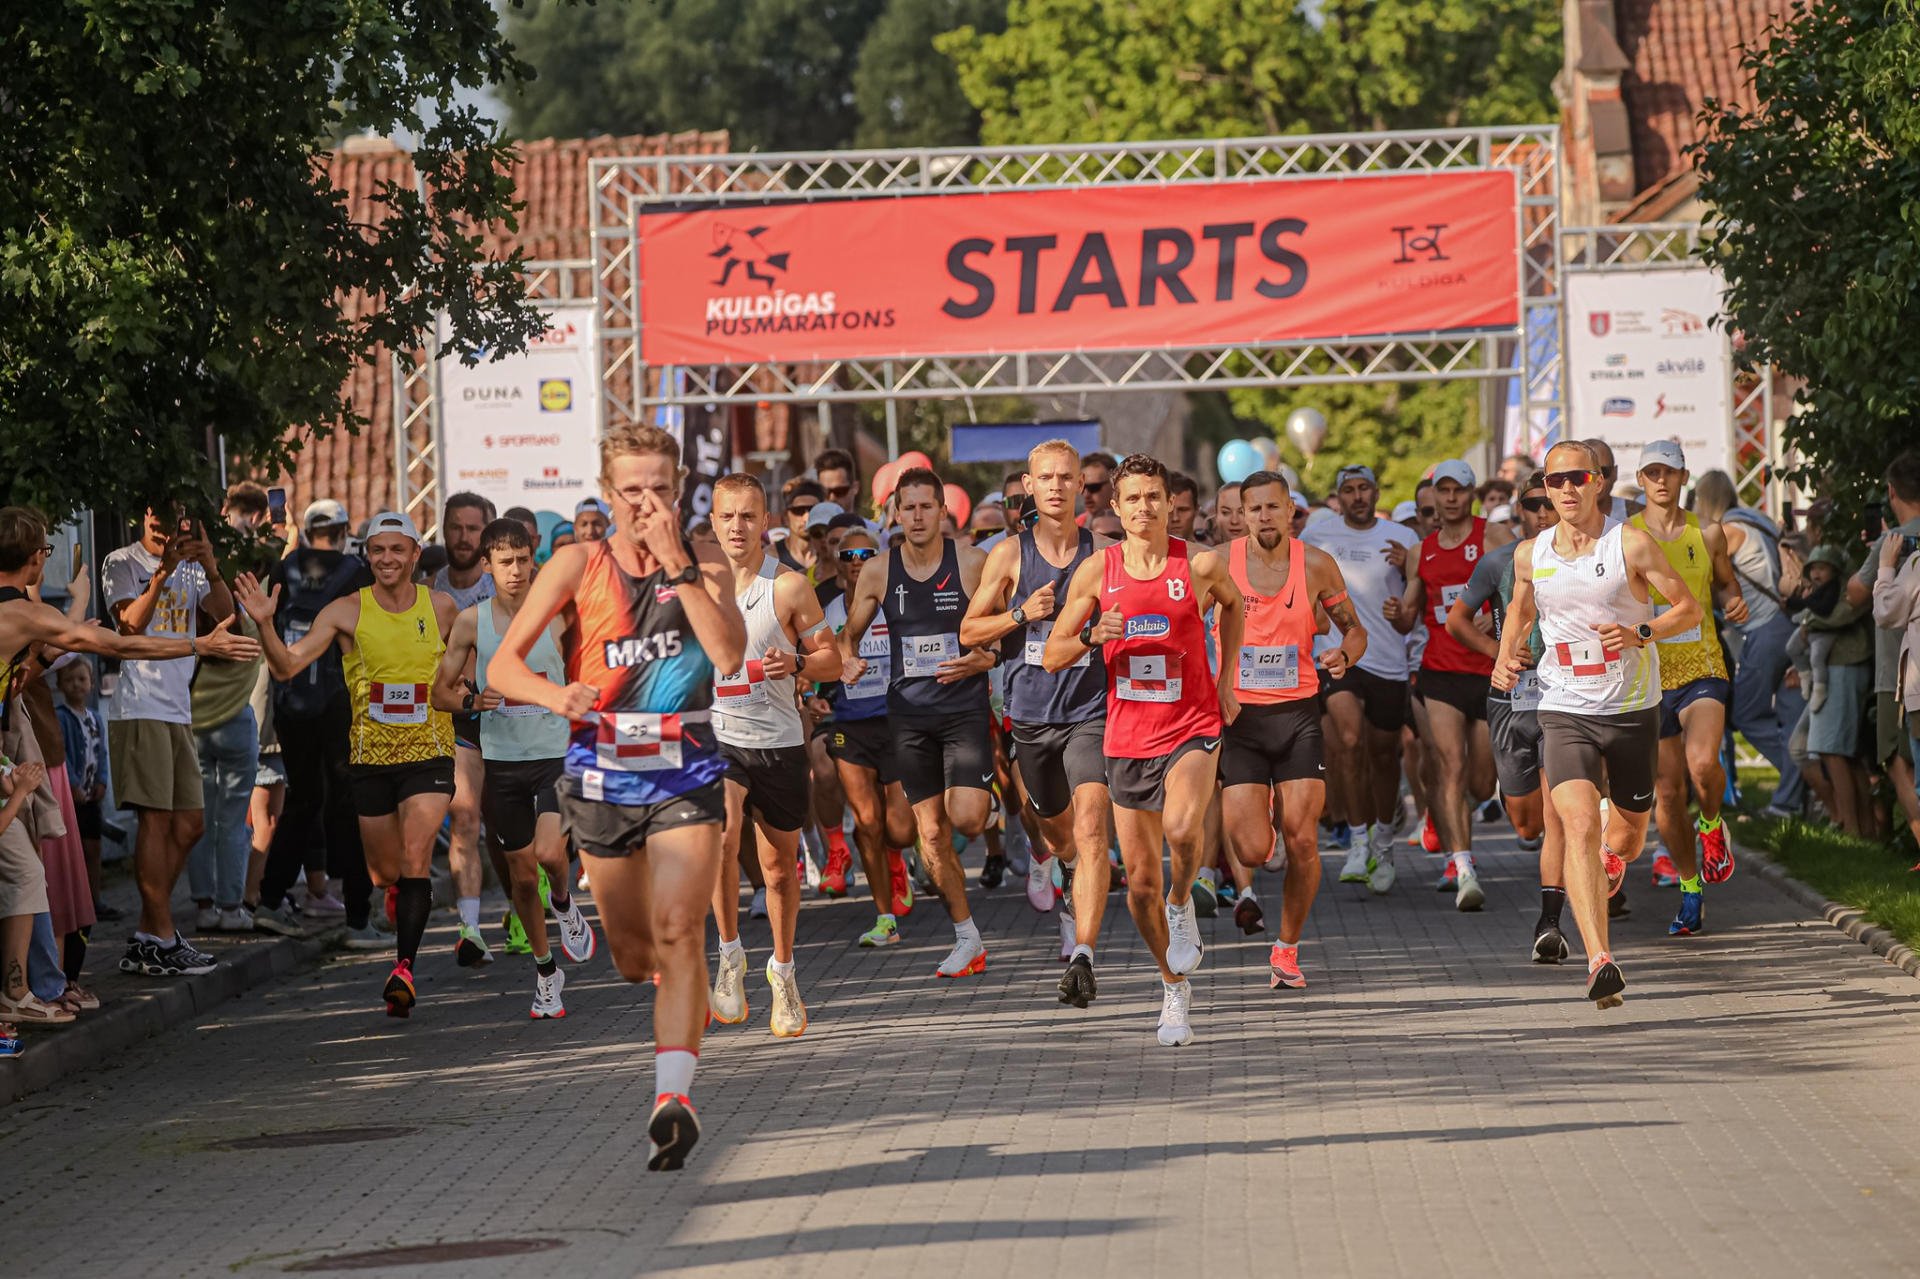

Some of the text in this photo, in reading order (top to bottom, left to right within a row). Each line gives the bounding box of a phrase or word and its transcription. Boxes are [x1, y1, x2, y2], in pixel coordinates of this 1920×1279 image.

[941, 217, 1310, 320] STARTS
[706, 289, 836, 321] KULDĪGAS
[706, 309, 897, 336] PUSMARATONS
[463, 386, 523, 401] DUNA
[1127, 619, 1167, 635] Baltais
[1494, 608, 1502, 642] AUGAVA
[606, 629, 683, 669] MK15
[919, 642, 940, 653] 1012
[1259, 654, 1283, 664] 1017
[1584, 649, 1589, 660] 1
[866, 666, 878, 675] 07
[1143, 664, 1152, 675] 2
[1528, 678, 1538, 687] 13
[388, 690, 410, 700] 392
[627, 725, 647, 738] 29
